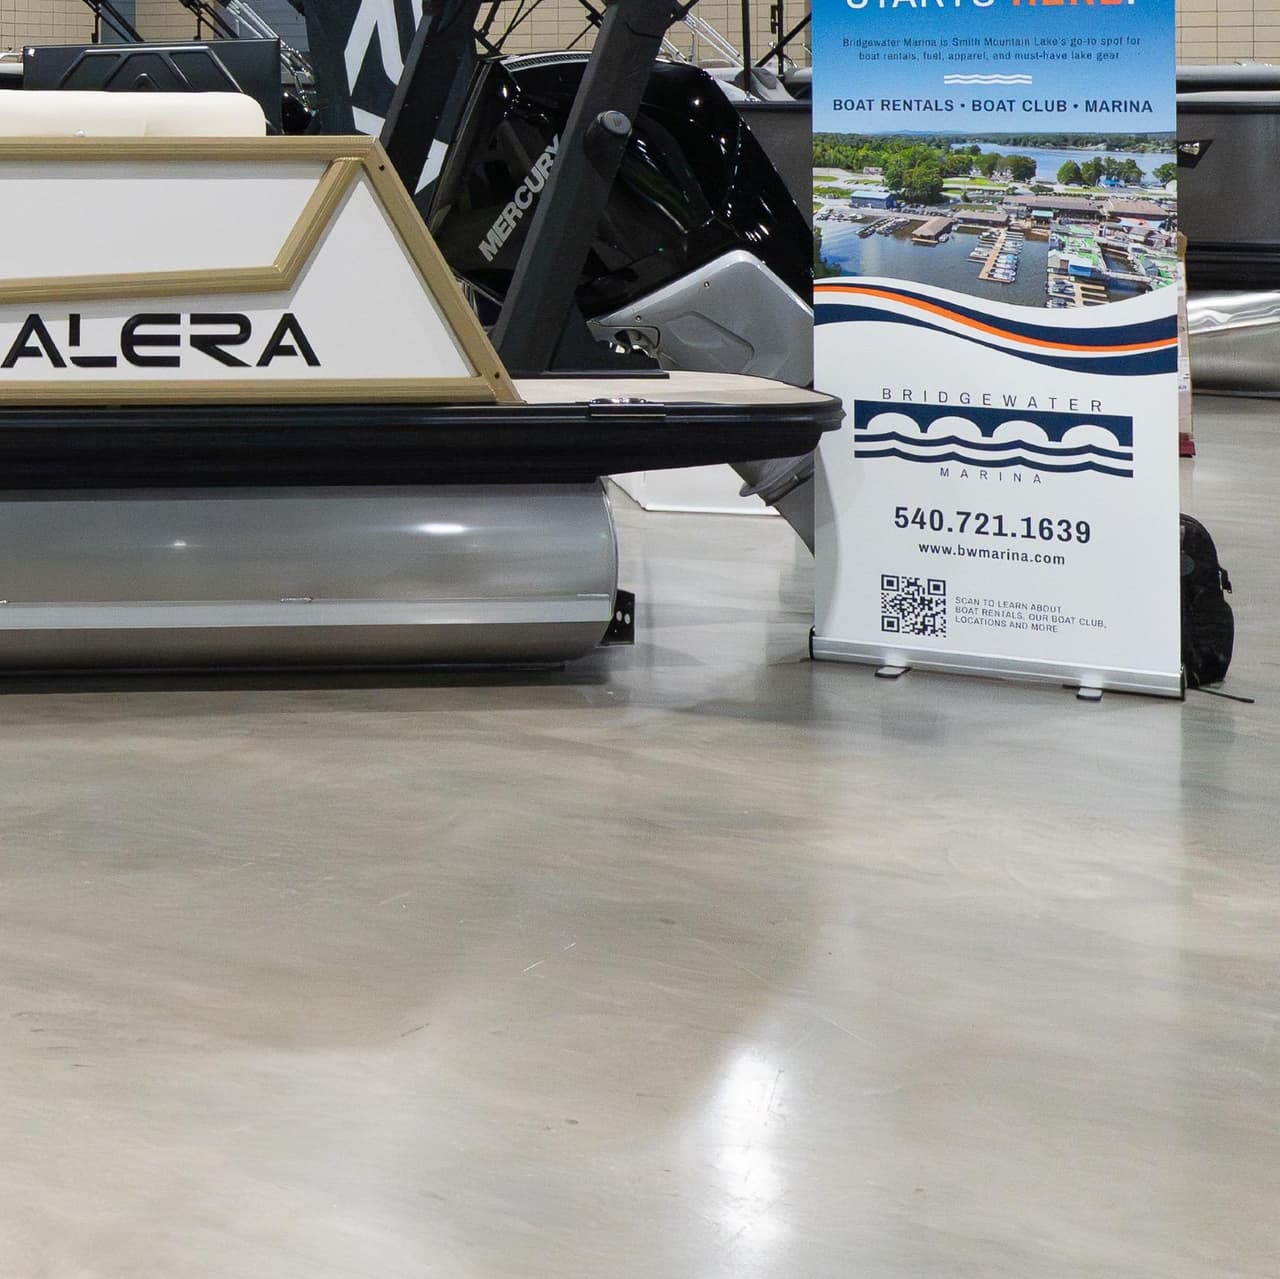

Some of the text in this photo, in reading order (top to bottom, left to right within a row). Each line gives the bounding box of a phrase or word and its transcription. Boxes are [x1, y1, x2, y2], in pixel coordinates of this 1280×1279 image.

[842, 36, 1141, 49] Bridgewater Marina is Smith Mountain Lake's go-to spot for
[858, 51, 880, 61] boat
[883, 51, 919, 62] rentals,
[923, 51, 945, 62] fuel,
[948, 51, 989, 63] apparel,
[992, 51, 1011, 60] and
[1014, 51, 1068, 60] must-have
[1071, 51, 1092, 60] lake
[833, 99, 1153, 113] BOAT RENTALS BOAT CLUB MARINA
[0, 313, 321, 368] ALERA
[882, 388, 1103, 412] BRIDGEWATER
[940, 467, 1042, 484] MARINA
[894, 506, 1091, 544] 540.721.1639
[918, 543, 1066, 566] www.bwmarina.com
[955, 596, 1062, 614] SCAN TO LEARN ABOUT
[955, 606, 979, 616] BOAT
[1028, 613, 1049, 622] OUR
[1051, 615, 1076, 625] BOAT
[955, 616, 1058, 633] LOCATIONS AND MORE
